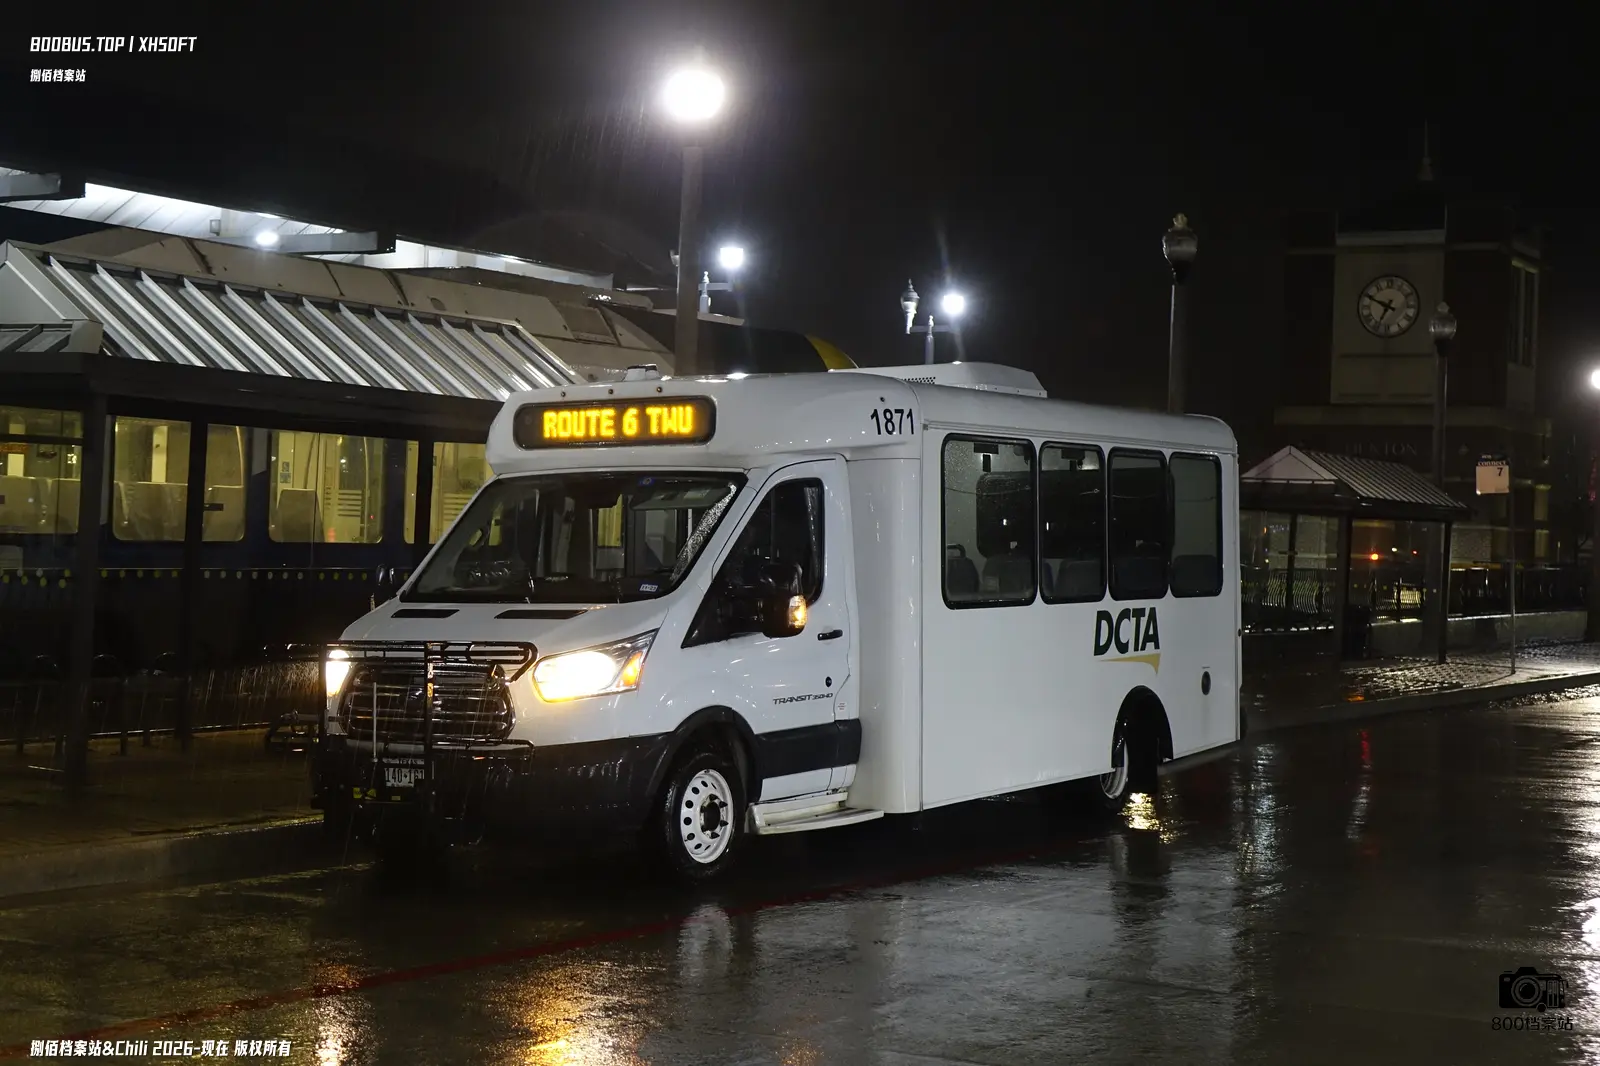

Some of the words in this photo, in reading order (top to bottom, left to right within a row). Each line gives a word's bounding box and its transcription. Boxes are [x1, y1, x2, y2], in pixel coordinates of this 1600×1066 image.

[542, 408, 616, 438] ROUTE
[622, 407, 639, 436] 6
[645, 404, 694, 434] TWU
[870, 408, 915, 435] 1871
[1496, 467, 1504, 477] 7
[1093, 606, 1160, 656] DCTA
[772, 694, 812, 705] TRANSIT
